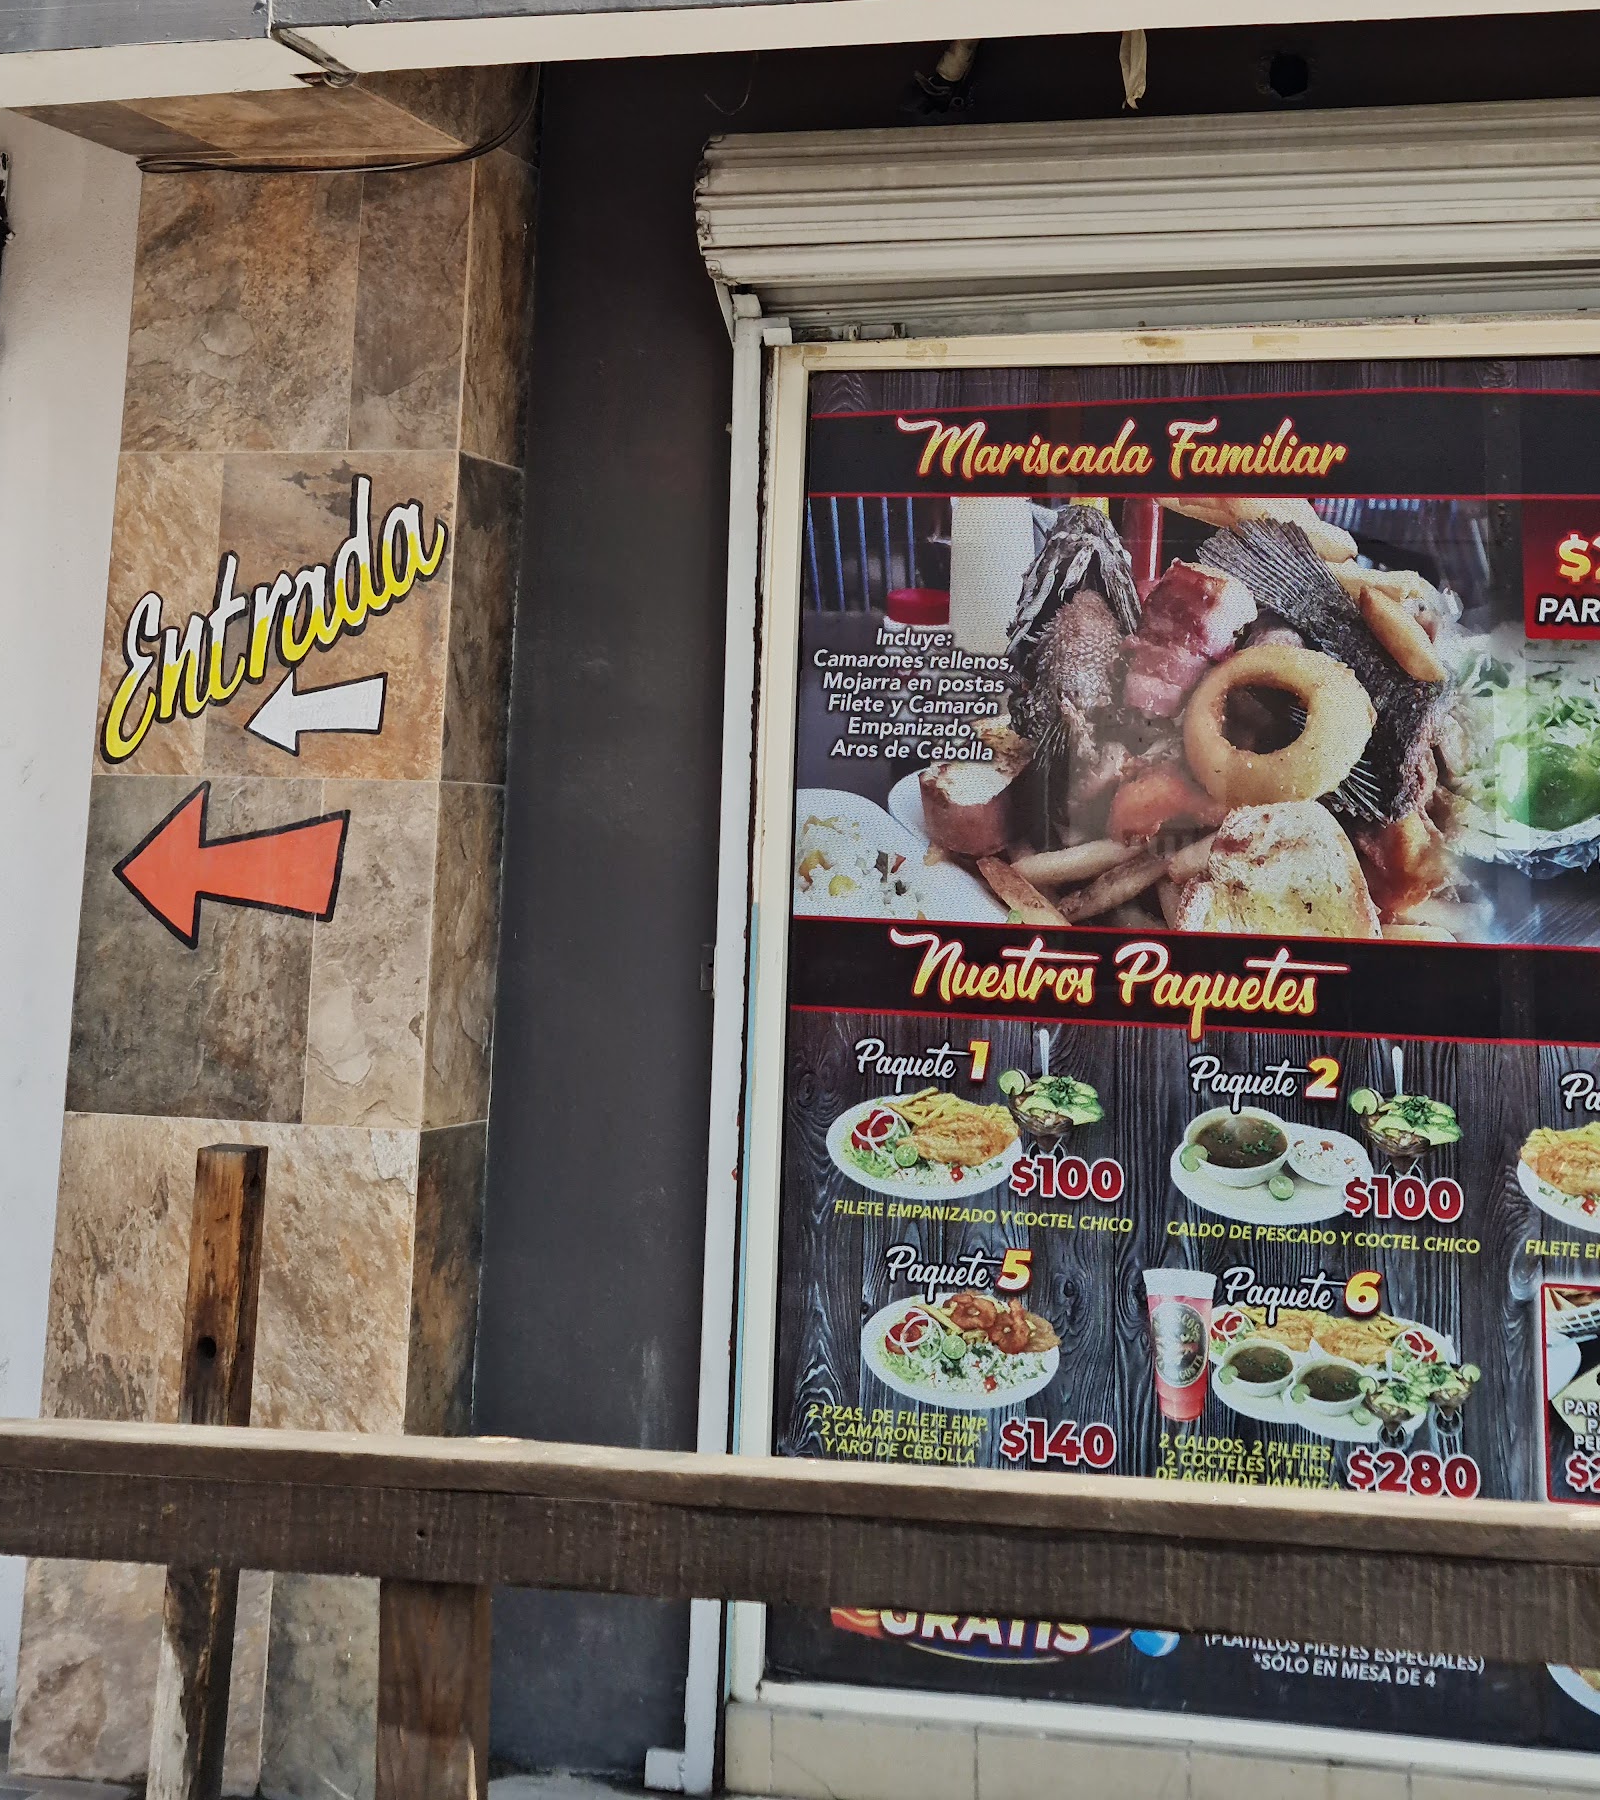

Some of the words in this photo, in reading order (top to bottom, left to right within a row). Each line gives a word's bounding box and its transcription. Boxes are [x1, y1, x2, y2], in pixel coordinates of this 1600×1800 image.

[898, 416, 1153, 481] Mariscada
[1167, 416, 1347, 480] Familiar
[100, 473, 449, 765] Entrada
[876, 627, 952, 650] Incluye:
[813, 649, 924, 669] Camarones
[929, 651, 1014, 672] rellenos,
[823, 672, 901, 694] Mojarra
[908, 679, 931, 691] en
[937, 678, 1004, 696] postas
[828, 694, 884, 713] Filete
[889, 700, 903, 717] y
[909, 695, 998, 715] Camarón
[848, 716, 976, 740] Empanizado,
[830, 739, 877, 758] Aros
[885, 740, 910, 759] de
[917, 740, 993, 761] Cebolla
[889, 927, 1100, 1005] Nuestros
[1112, 940, 1350, 1040] Paquetes
[855, 1037, 970, 1093] Paquete
[969, 1039, 990, 1082] 1
[1189, 1055, 1309, 1112] Paquete
[1305, 1056, 1340, 1099] 2
[1009, 1155, 1124, 1202] $100
[1343, 1174, 1463, 1222] $100
[834, 1199, 884, 1218] FILETE
[888, 1204, 996, 1224] EMPANIZADO
[1015, 1211, 1075, 1229] COCTEL
[1080, 1215, 1133, 1232] CHICO
[886, 1245, 1003, 1303] Paquete
[996, 1248, 1032, 1292] 5
[1222, 1266, 1348, 1327] Paquete
[1343, 1270, 1382, 1316] 6
[1000, 1418, 1117, 1469] $140
[1348, 1446, 1481, 1499] $280
